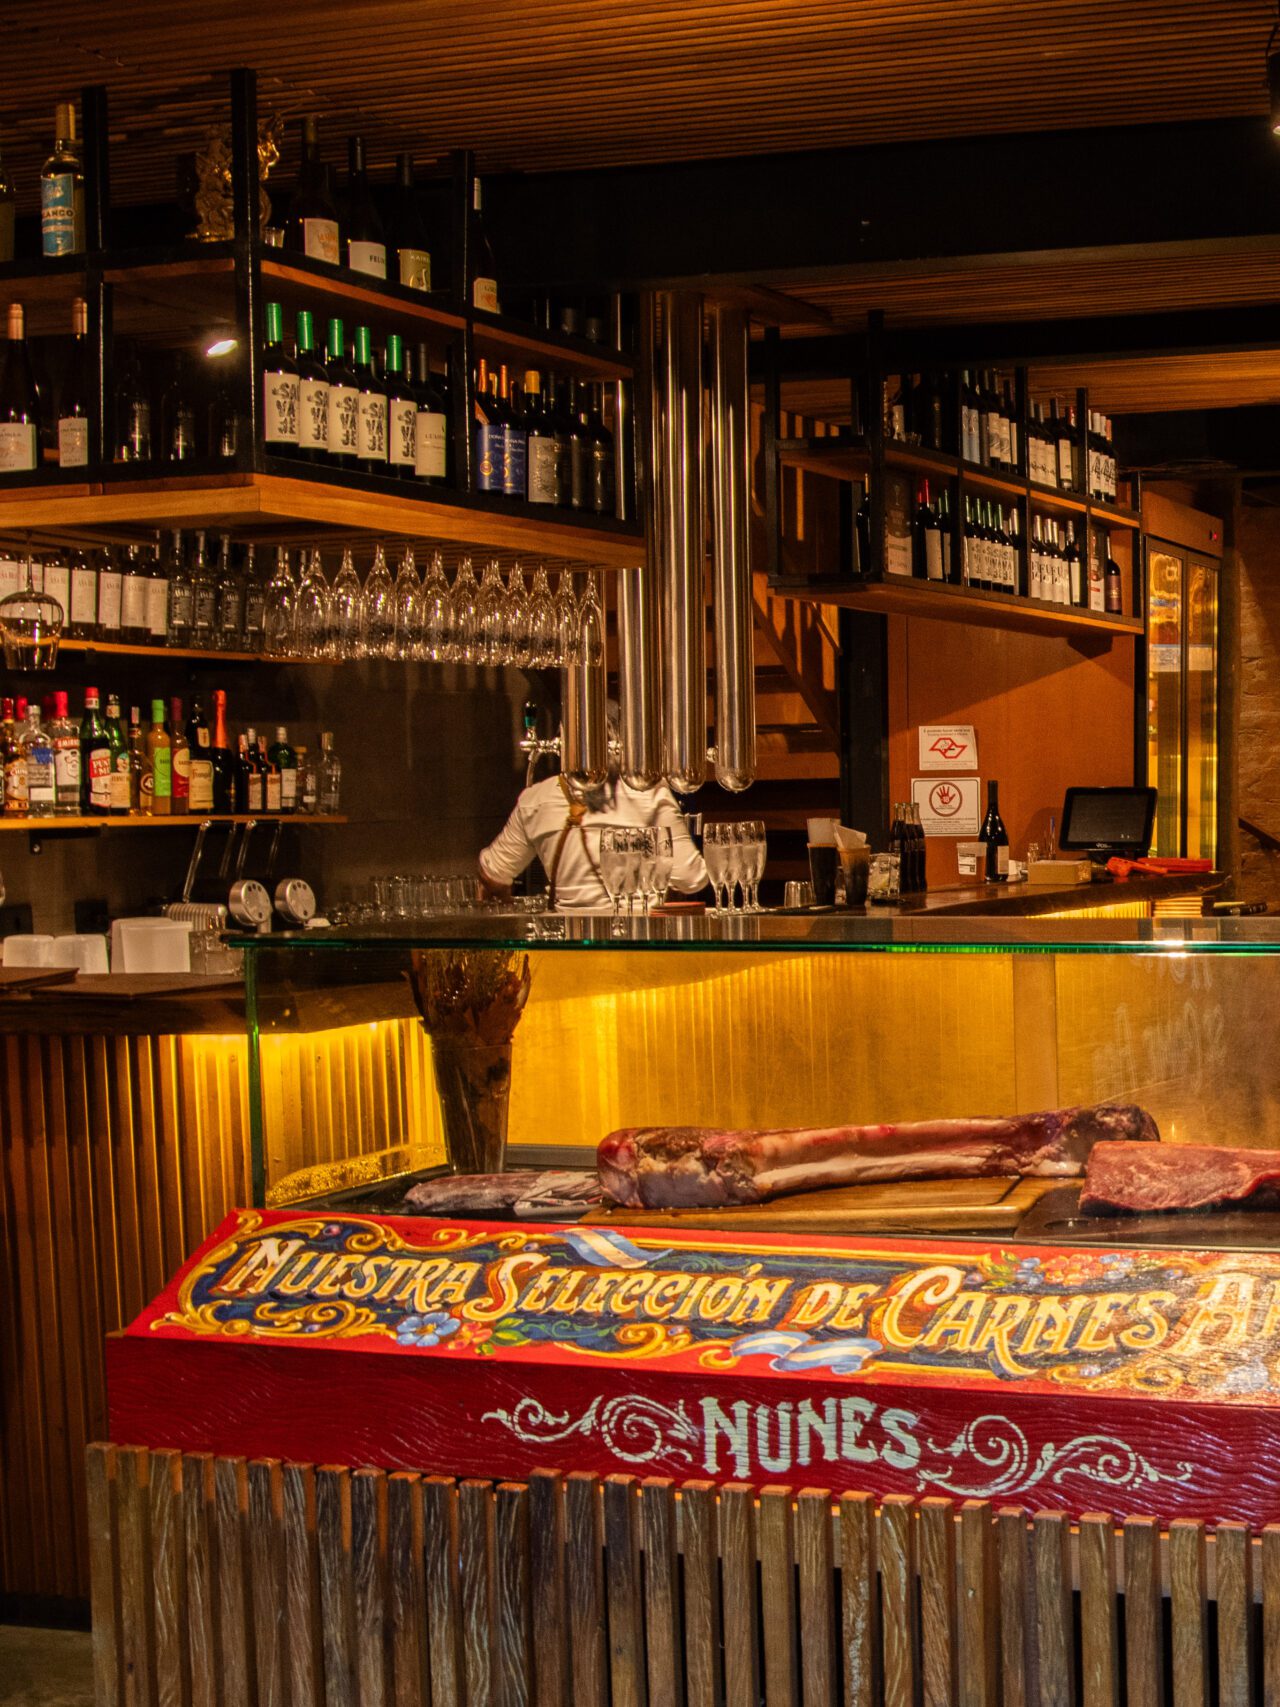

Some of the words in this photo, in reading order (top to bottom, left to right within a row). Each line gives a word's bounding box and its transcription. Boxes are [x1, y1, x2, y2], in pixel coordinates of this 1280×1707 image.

[222, 1236, 479, 1312] NUESTRA
[462, 1251, 793, 1326] SELECCIÓN
[794, 1281, 878, 1331] DE
[881, 1265, 1185, 1376] CARNES
[699, 1395, 923, 1478] NUNES
